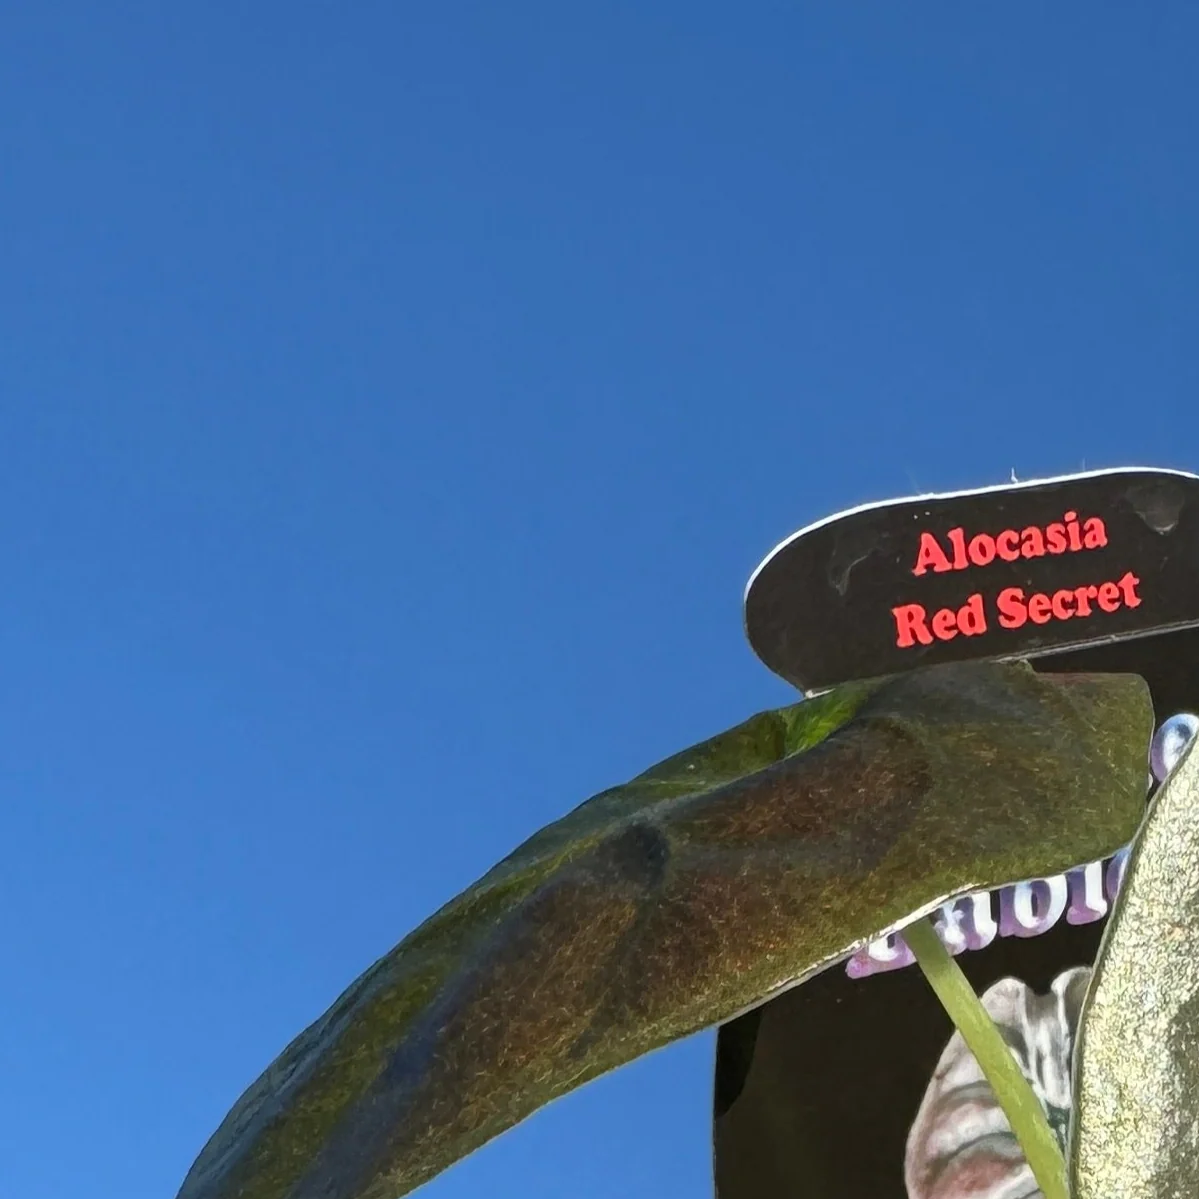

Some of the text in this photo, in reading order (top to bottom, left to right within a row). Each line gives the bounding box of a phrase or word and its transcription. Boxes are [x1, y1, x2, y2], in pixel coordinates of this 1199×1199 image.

[912, 510, 1108, 576] Alocasia
[892, 571, 1142, 649] Red Secret
